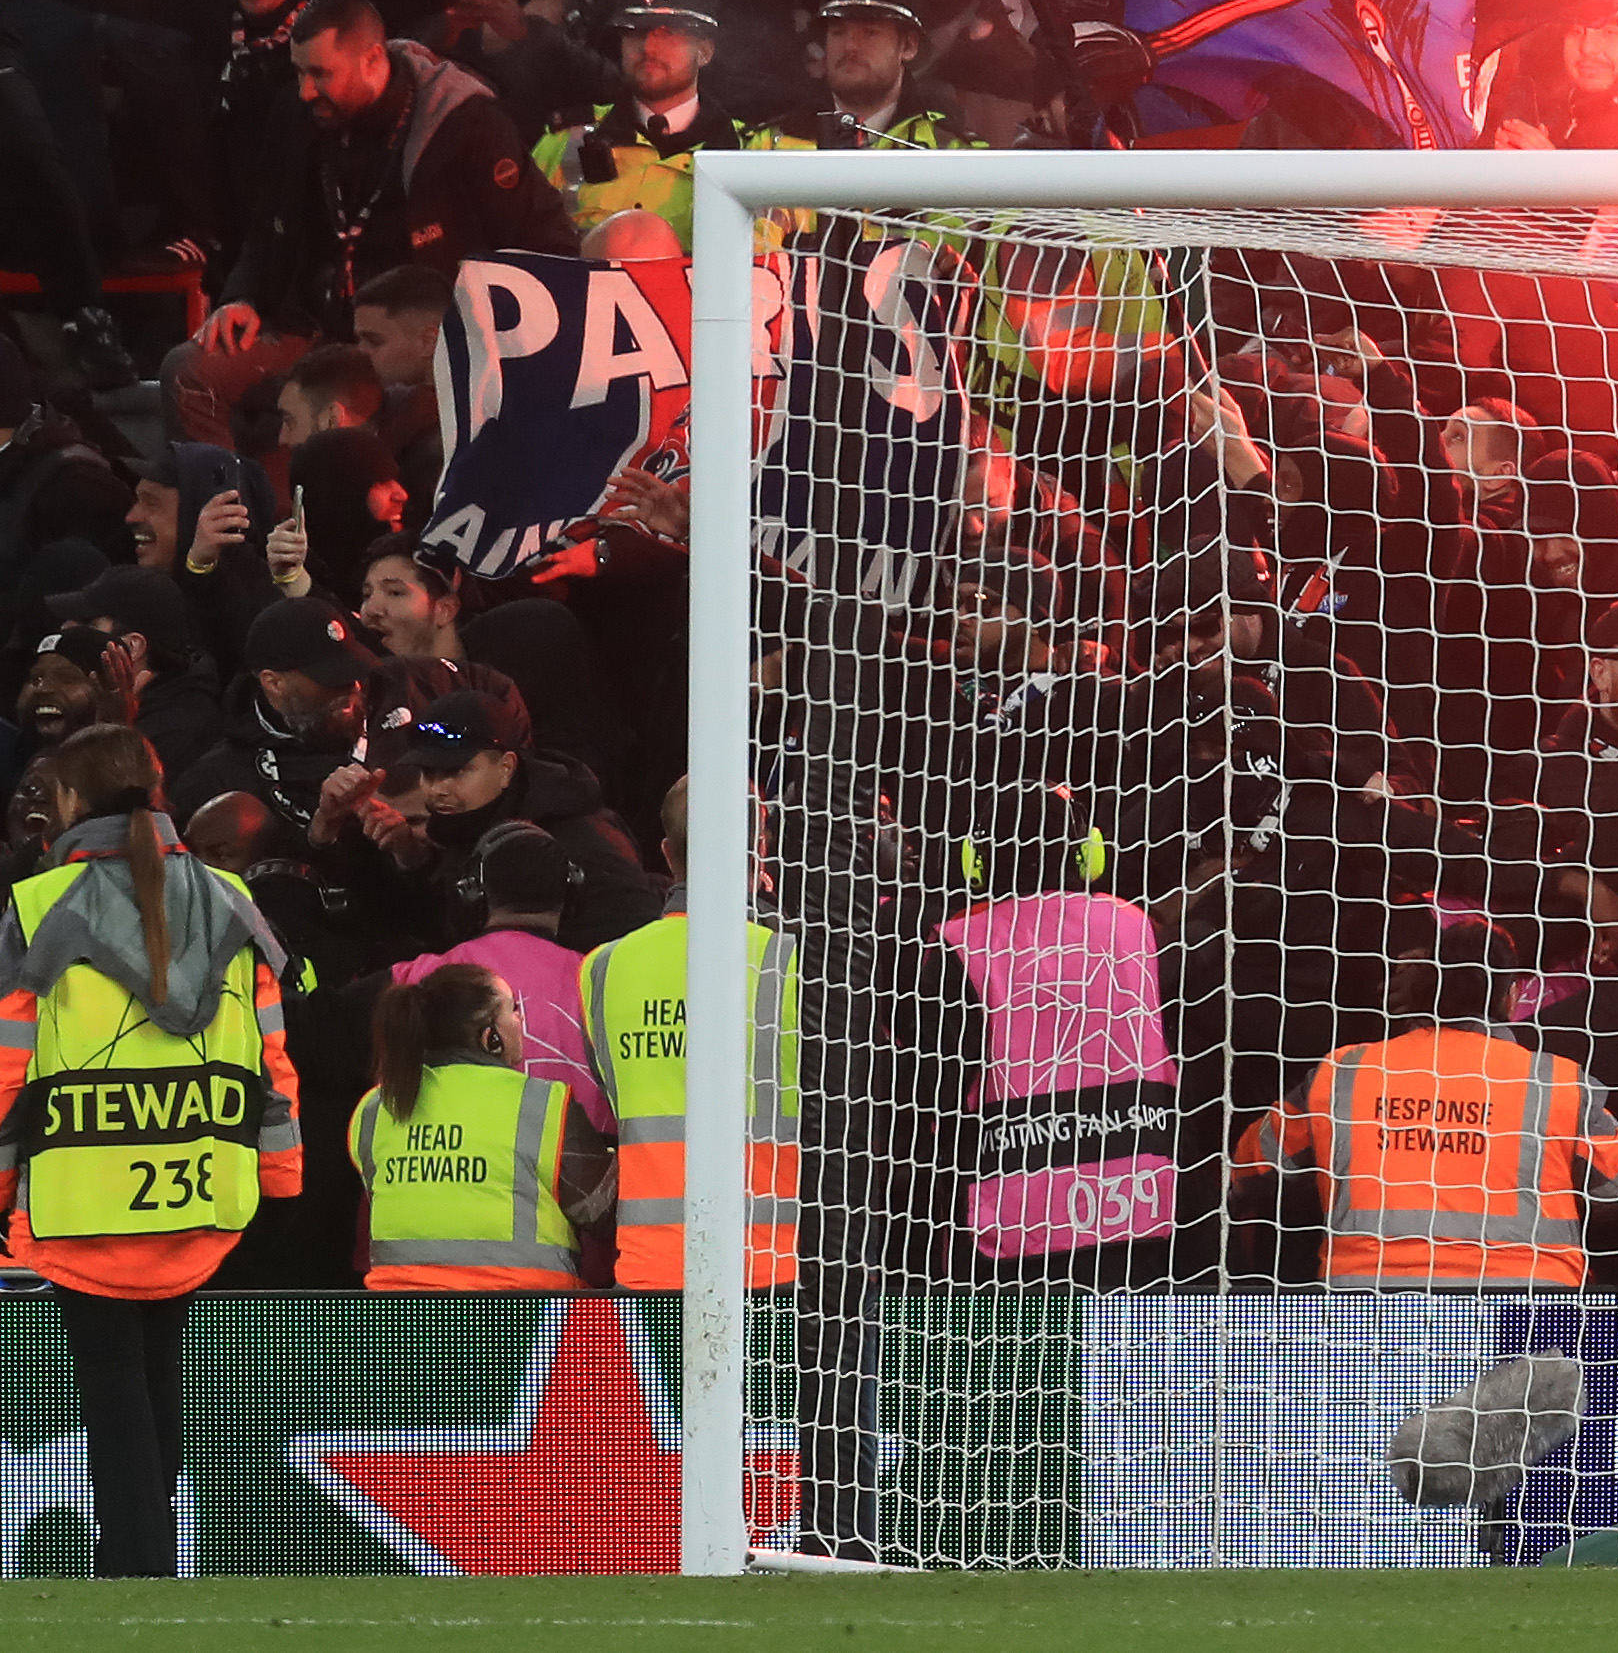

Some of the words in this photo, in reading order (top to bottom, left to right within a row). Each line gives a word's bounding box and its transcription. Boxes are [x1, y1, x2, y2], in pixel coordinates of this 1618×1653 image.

[643, 998, 687, 1027] HEA
[619, 1029, 687, 1060] STEW
[1375, 1096, 1494, 1126] RESPONSE
[407, 1124, 463, 1152] HEAD
[1377, 1127, 1487, 1155] STEWARD
[385, 1156, 487, 1184] STEWARD
[1066, 1169, 1160, 1232] 039
